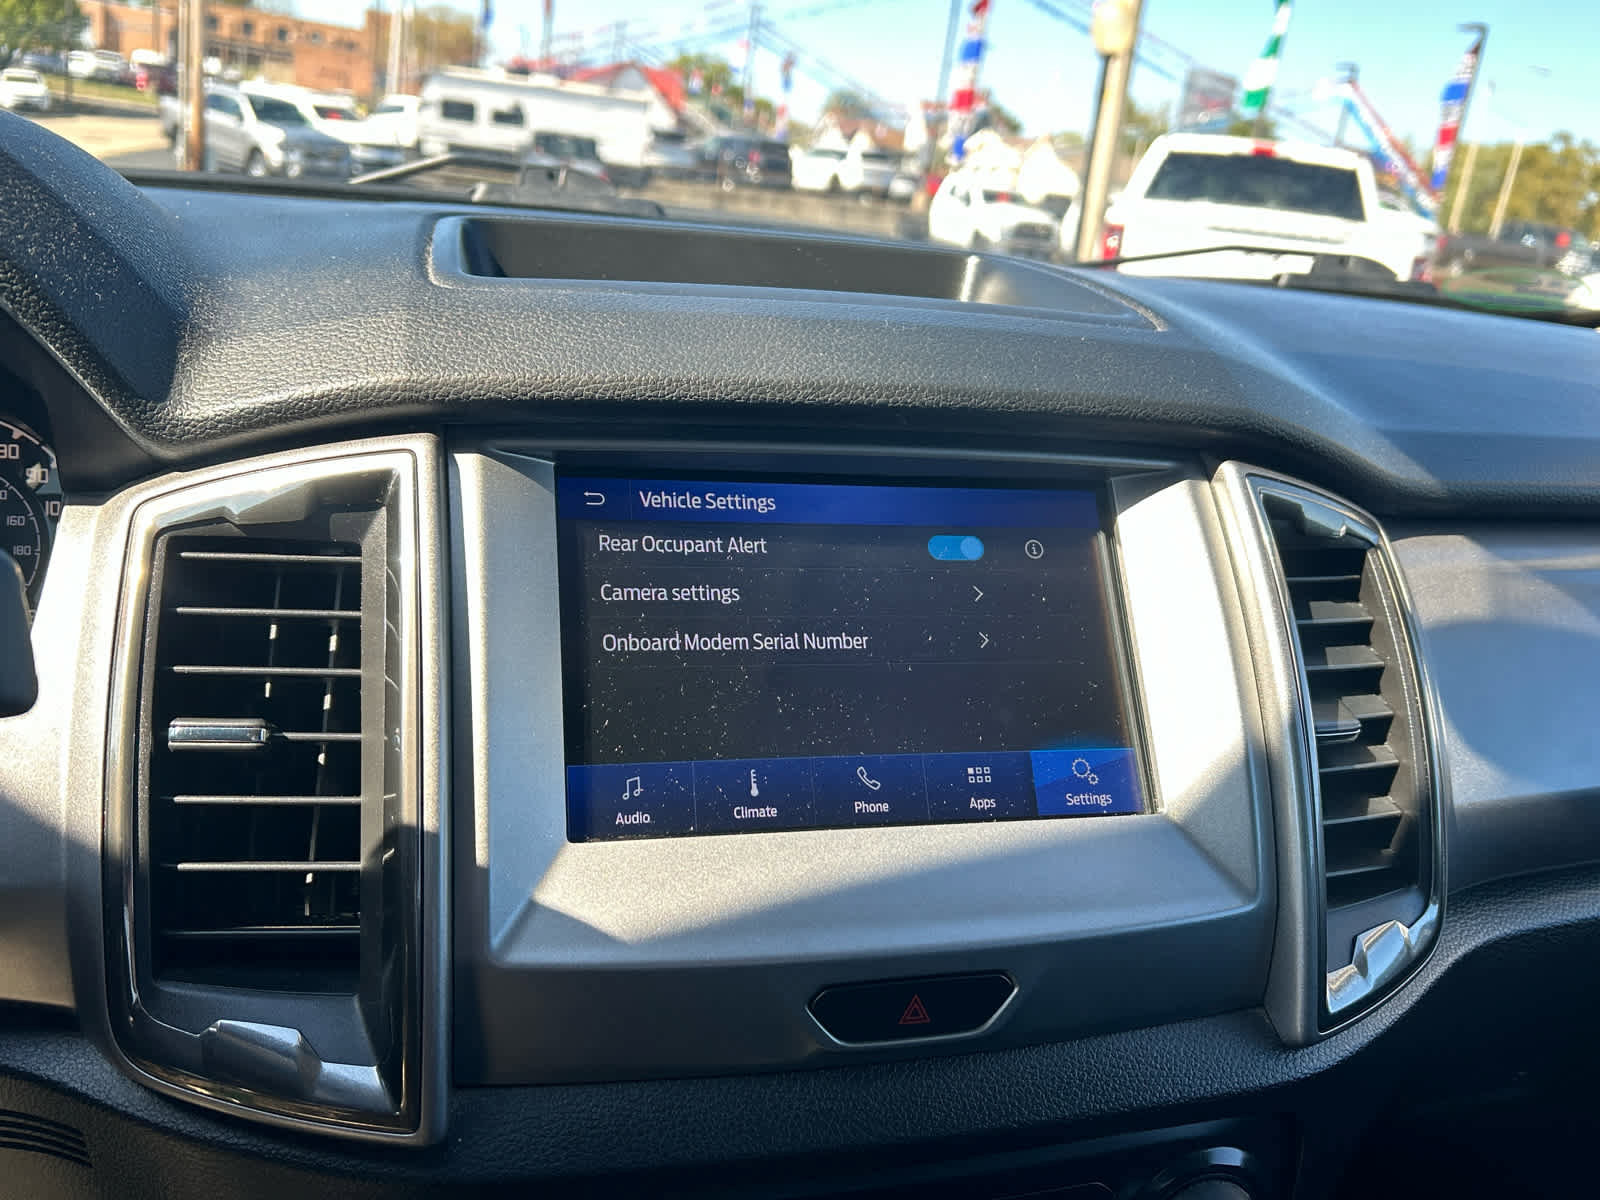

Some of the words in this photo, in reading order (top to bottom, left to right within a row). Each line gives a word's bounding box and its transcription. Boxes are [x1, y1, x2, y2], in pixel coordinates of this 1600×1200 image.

[25, 467, 49, 484] 90
[639, 490, 702, 510] Vehicle
[704, 492, 777, 513] Settings
[6, 515, 26, 527] 160
[13, 544, 32, 556] 180
[598, 534, 639, 552] Rear
[642, 535, 724, 556] Occupant
[727, 536, 768, 554] Alert
[600, 583, 668, 602] Camera
[671, 584, 740, 605] settings
[602, 632, 681, 652] Onboard
[684, 632, 749, 651] Modem
[752, 632, 801, 651] Serial
[803, 632, 869, 650] Number
[854, 800, 889, 814] Phone
[969, 796, 997, 812] Apps
[1065, 792, 1113, 808] Settings
[615, 811, 651, 826] Audio
[733, 805, 778, 820] Climate
